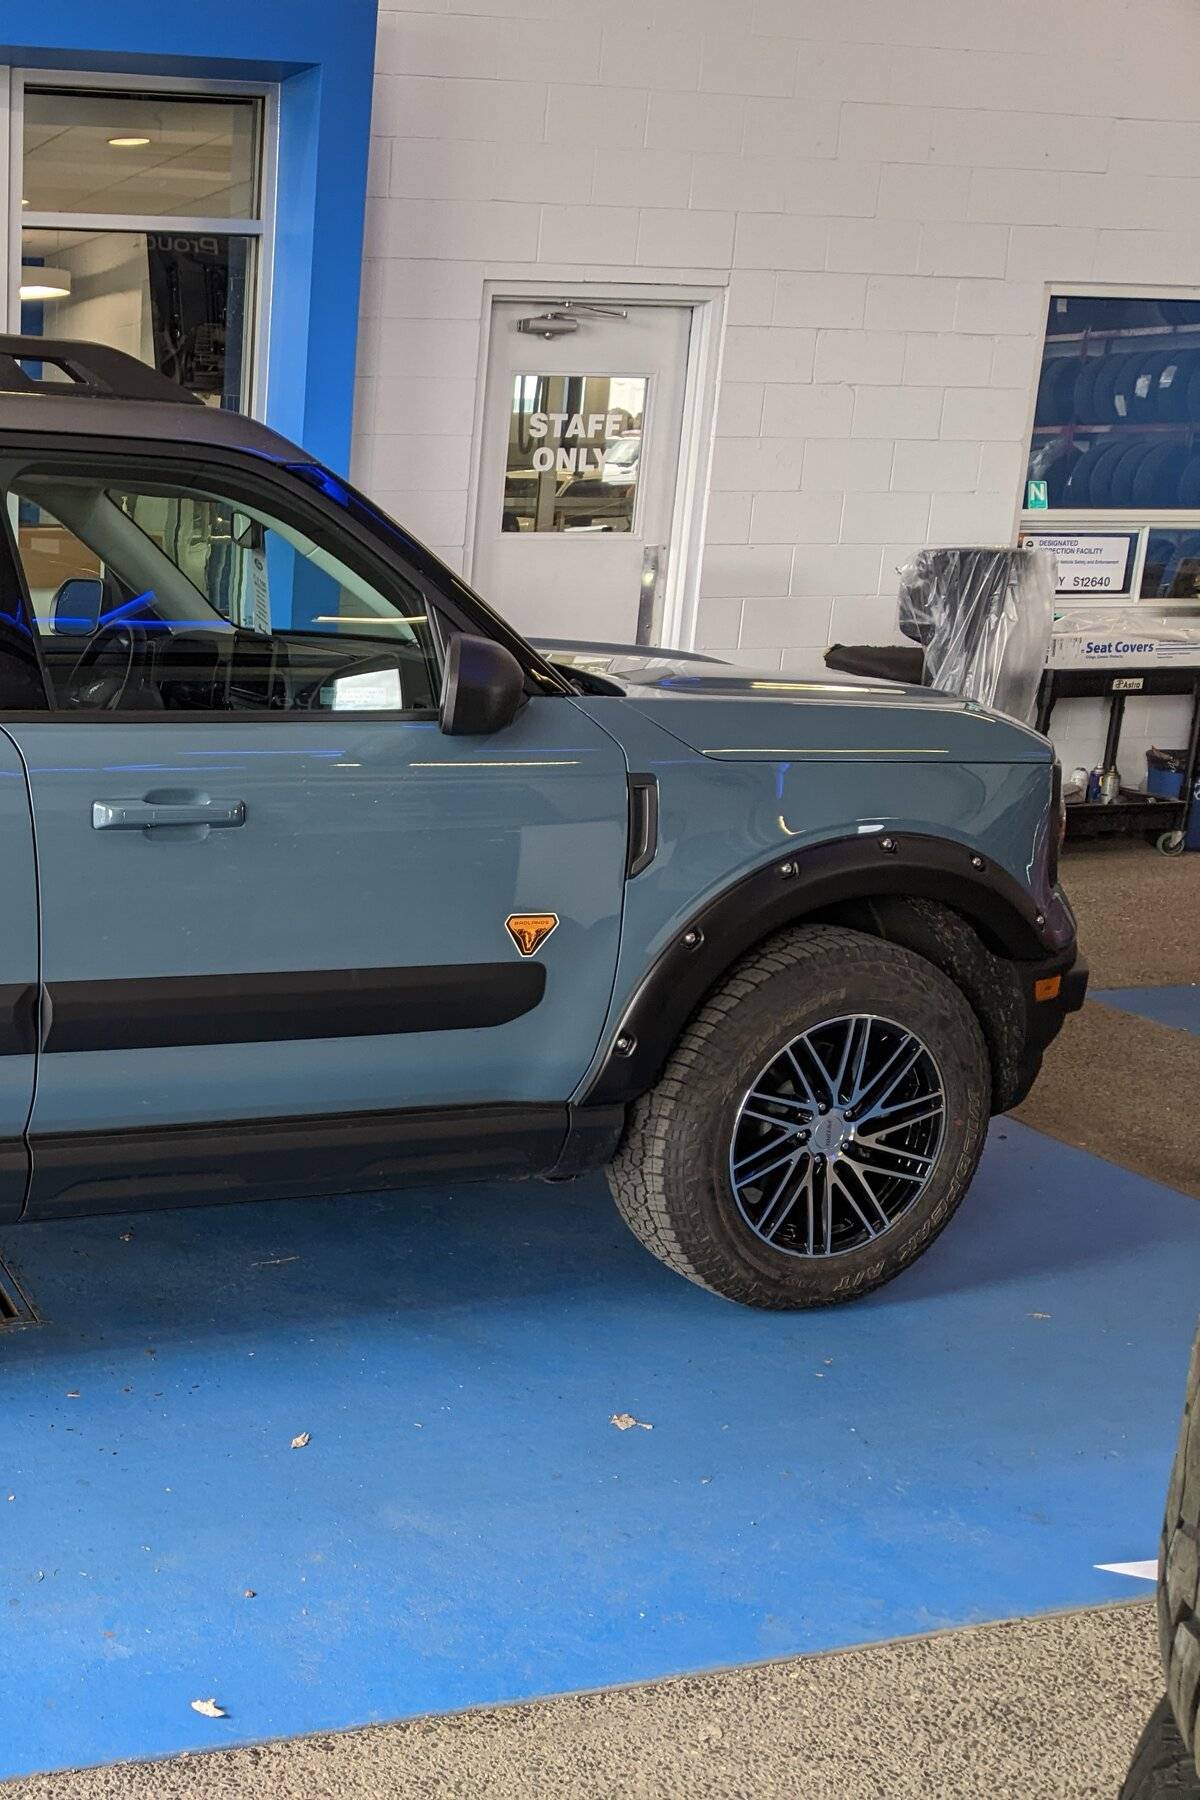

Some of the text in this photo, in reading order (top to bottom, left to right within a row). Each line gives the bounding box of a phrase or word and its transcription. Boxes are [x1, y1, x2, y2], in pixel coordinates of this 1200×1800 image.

[529, 413, 622, 438] STAFF
[532, 446, 609, 473] ONLY
[1030, 483, 1045, 500] N
[1076, 547, 1104, 555] FACILITY
[1073, 576, 1111, 587] S12640
[1086, 641, 1112, 653] Seat
[1115, 641, 1154, 653] Covers
[1123, 679, 1141, 689] Astro
